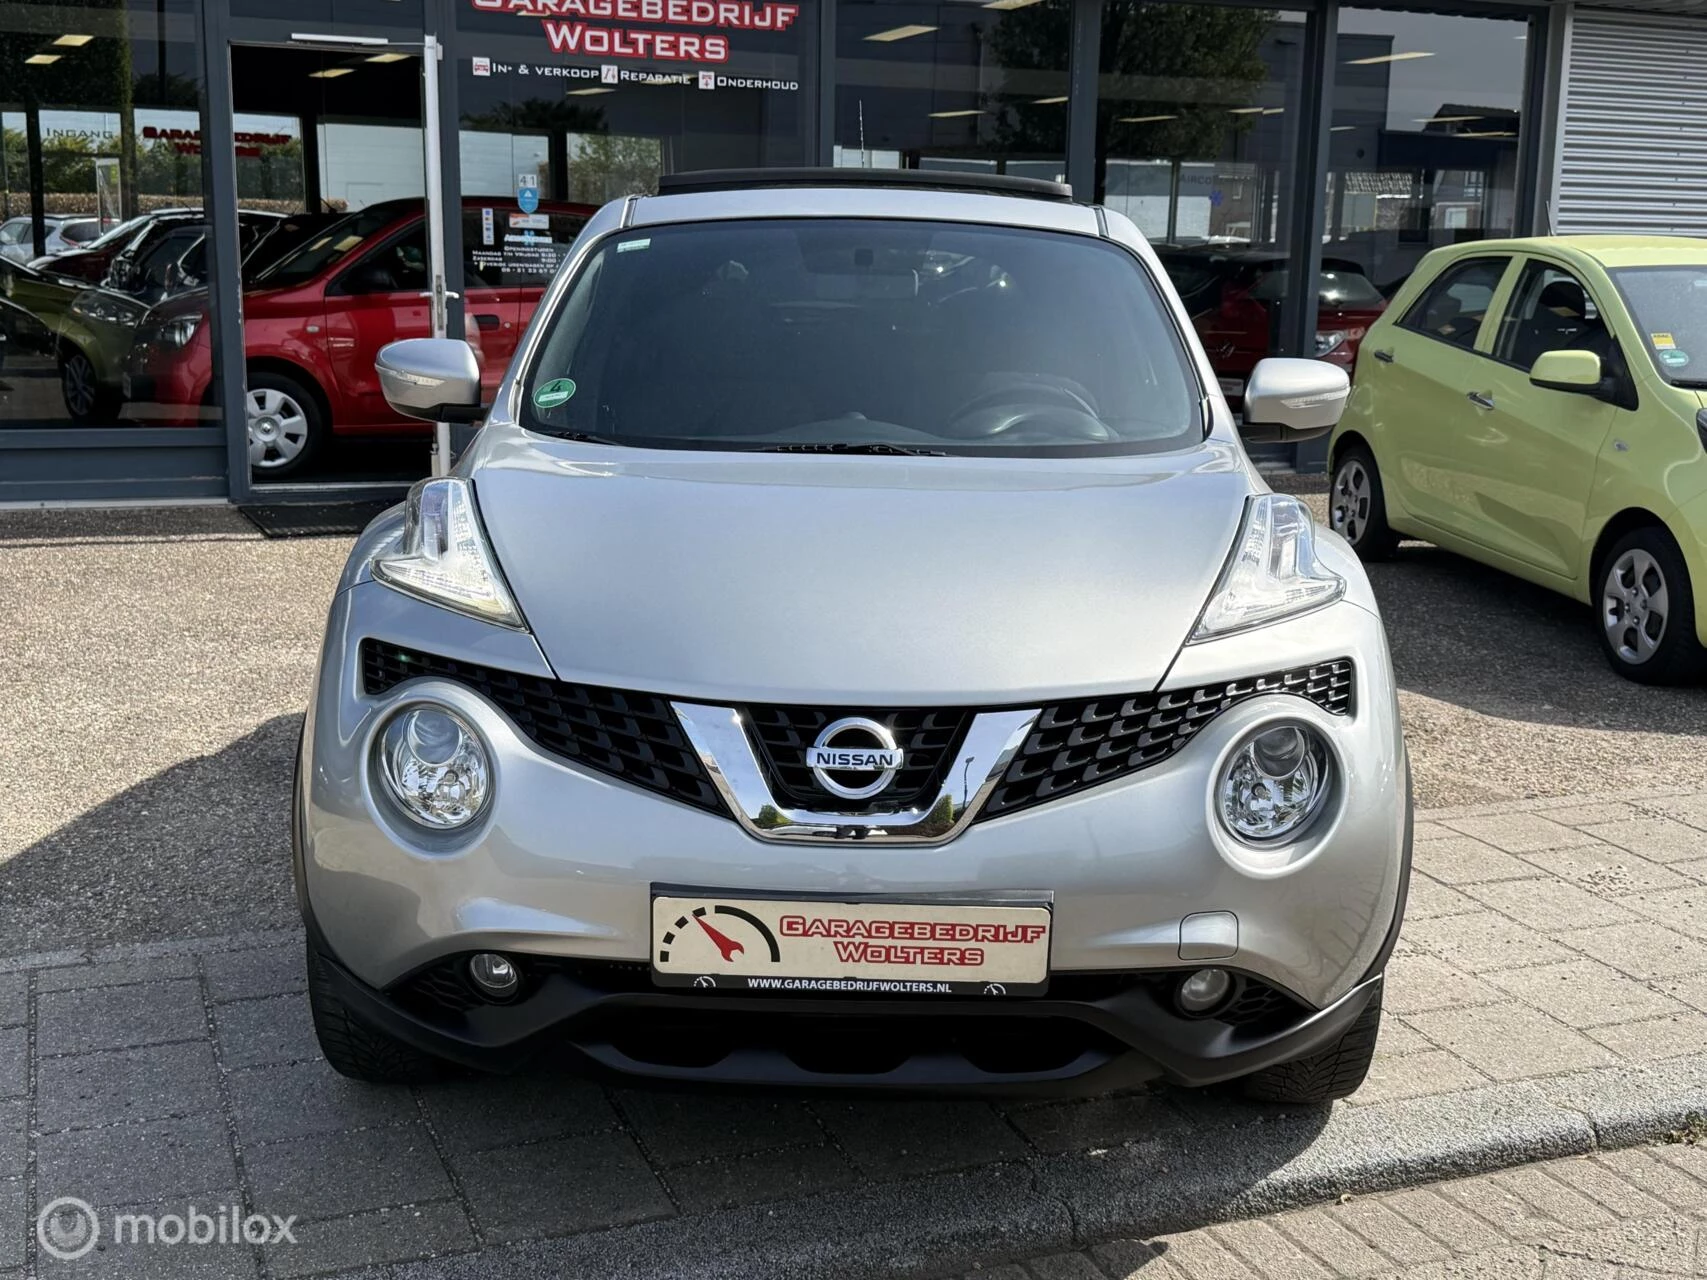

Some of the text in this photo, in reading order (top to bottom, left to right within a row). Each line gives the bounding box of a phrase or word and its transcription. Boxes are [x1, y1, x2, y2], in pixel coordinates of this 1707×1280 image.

[543, 20, 728, 62] WOLTERS
[518, 64, 529, 75] &
[535, 66, 600, 79] VERKOOP
[620, 70, 691, 85] REPARATIE
[717, 77, 798, 90] ONDERHOUD
[46, 127, 114, 140] INGANG
[816, 752, 893, 767] NISSAN
[779, 914, 1047, 944] GARAGEBEDRIJF
[834, 941, 985, 966] WOLTERS
[747, 977, 952, 994] WWW.GARAGEBEDRIJFWOLTERS.NL
